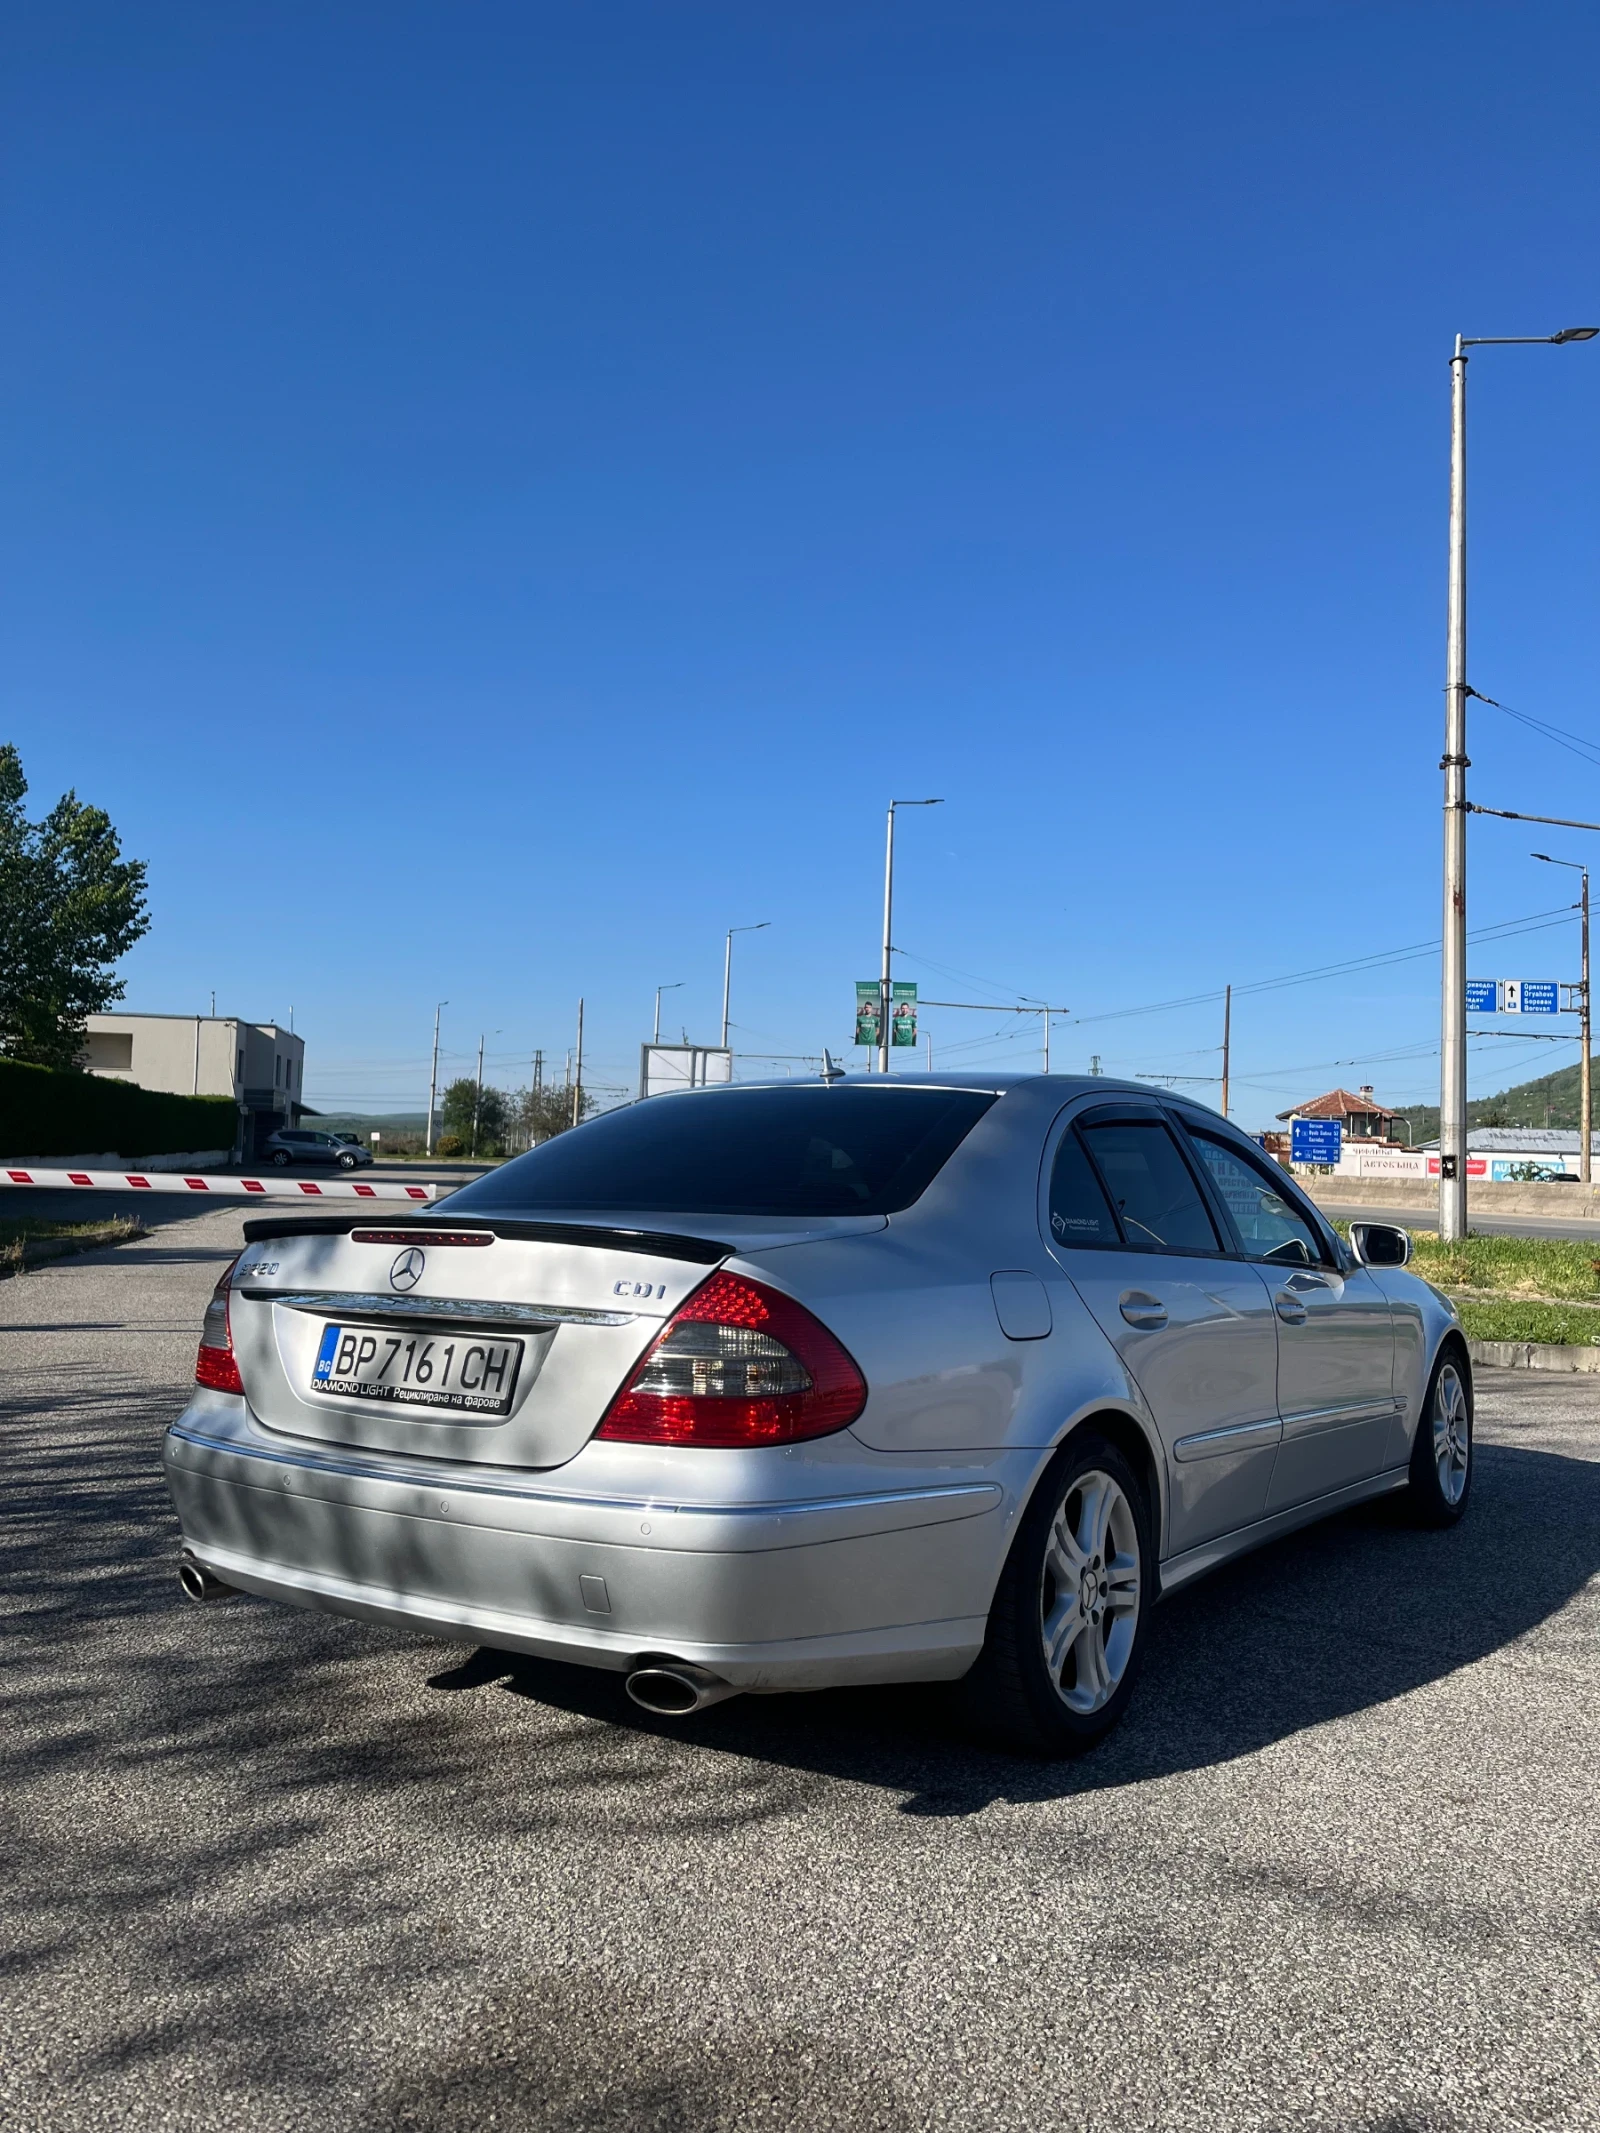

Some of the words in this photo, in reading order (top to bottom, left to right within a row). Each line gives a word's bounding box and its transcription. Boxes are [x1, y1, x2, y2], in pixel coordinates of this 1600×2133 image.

[1364, 1160, 1419, 1170] АВТОКЪЩА
[613, 1280, 666, 1299] CDI
[318, 1360, 331, 1373] BG
[312, 1379, 359, 1393] DIAMOND
[360, 1384, 389, 1397] LIGHT
[393, 1387, 449, 1403] Рециклиране
[451, 1396, 462, 1404] на
[464, 1395, 500, 1408] фарове
